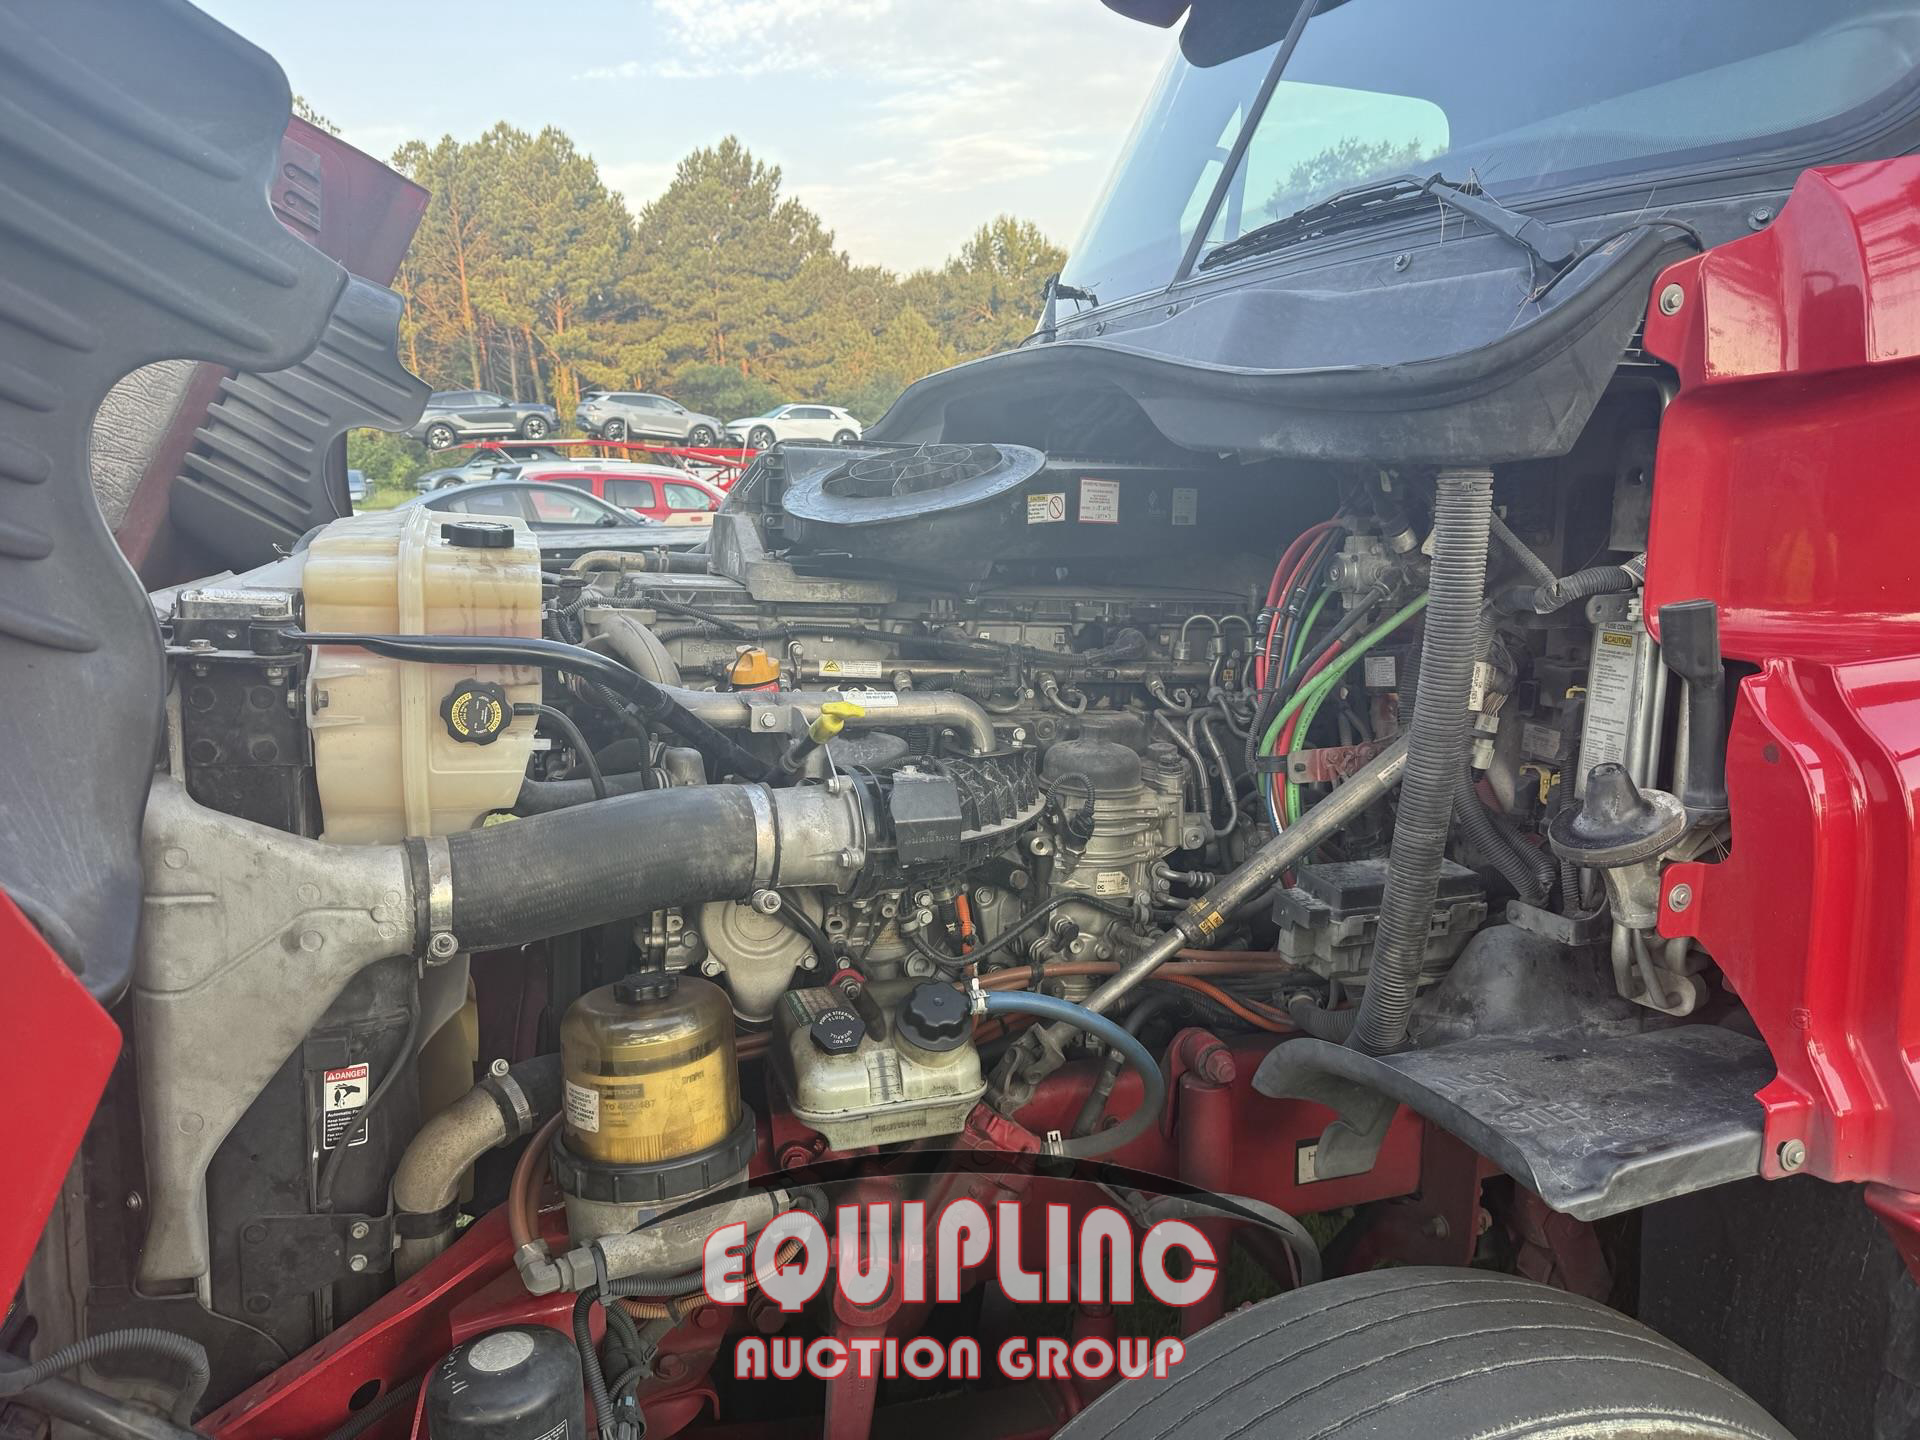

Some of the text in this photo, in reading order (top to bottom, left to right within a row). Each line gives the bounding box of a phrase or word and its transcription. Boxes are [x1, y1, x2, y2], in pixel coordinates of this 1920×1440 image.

[1608, 635, 1632, 646] CAUTION
[819, 1010, 855, 1025] POWER STEERING
[335, 1069, 366, 1080] DANGER
[601, 1088, 641, 1096] DETROIT
